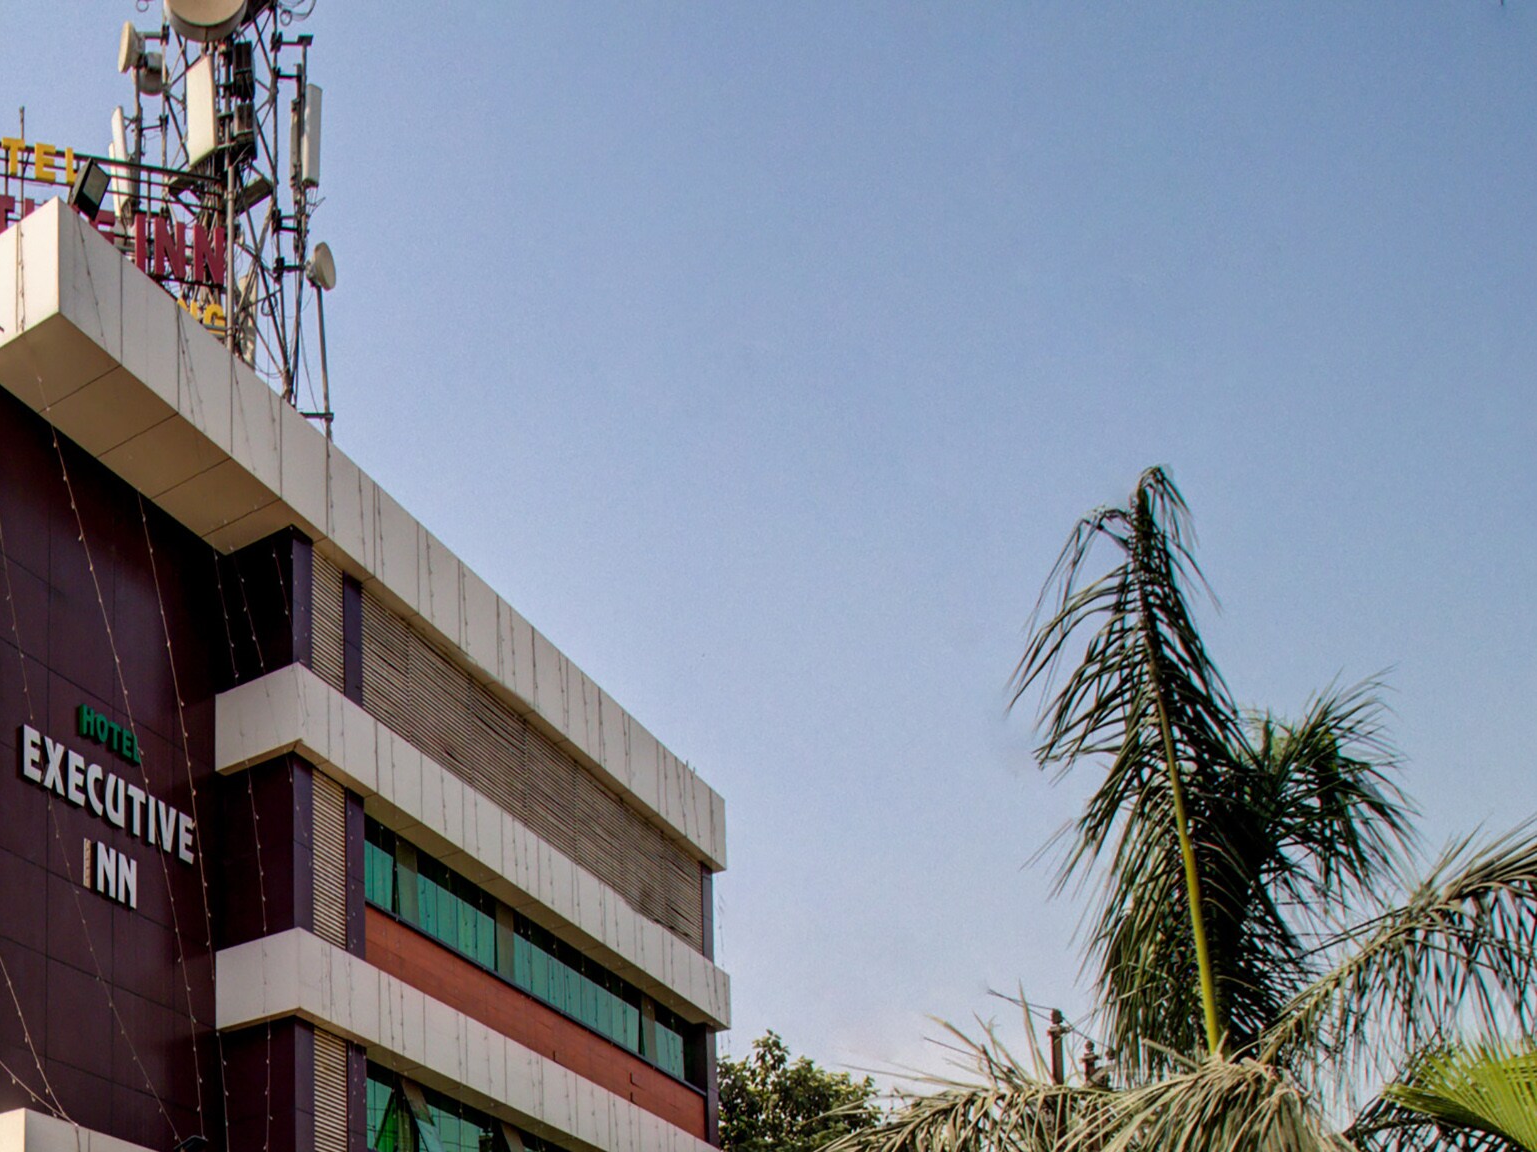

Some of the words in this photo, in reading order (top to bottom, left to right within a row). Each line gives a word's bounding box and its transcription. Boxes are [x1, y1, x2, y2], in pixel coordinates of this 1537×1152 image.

[134, 211, 226, 287] INN
[77, 702, 142, 765] HOTEL
[18, 723, 196, 866] EXECUTIVE
[82, 836, 138, 910] INN
